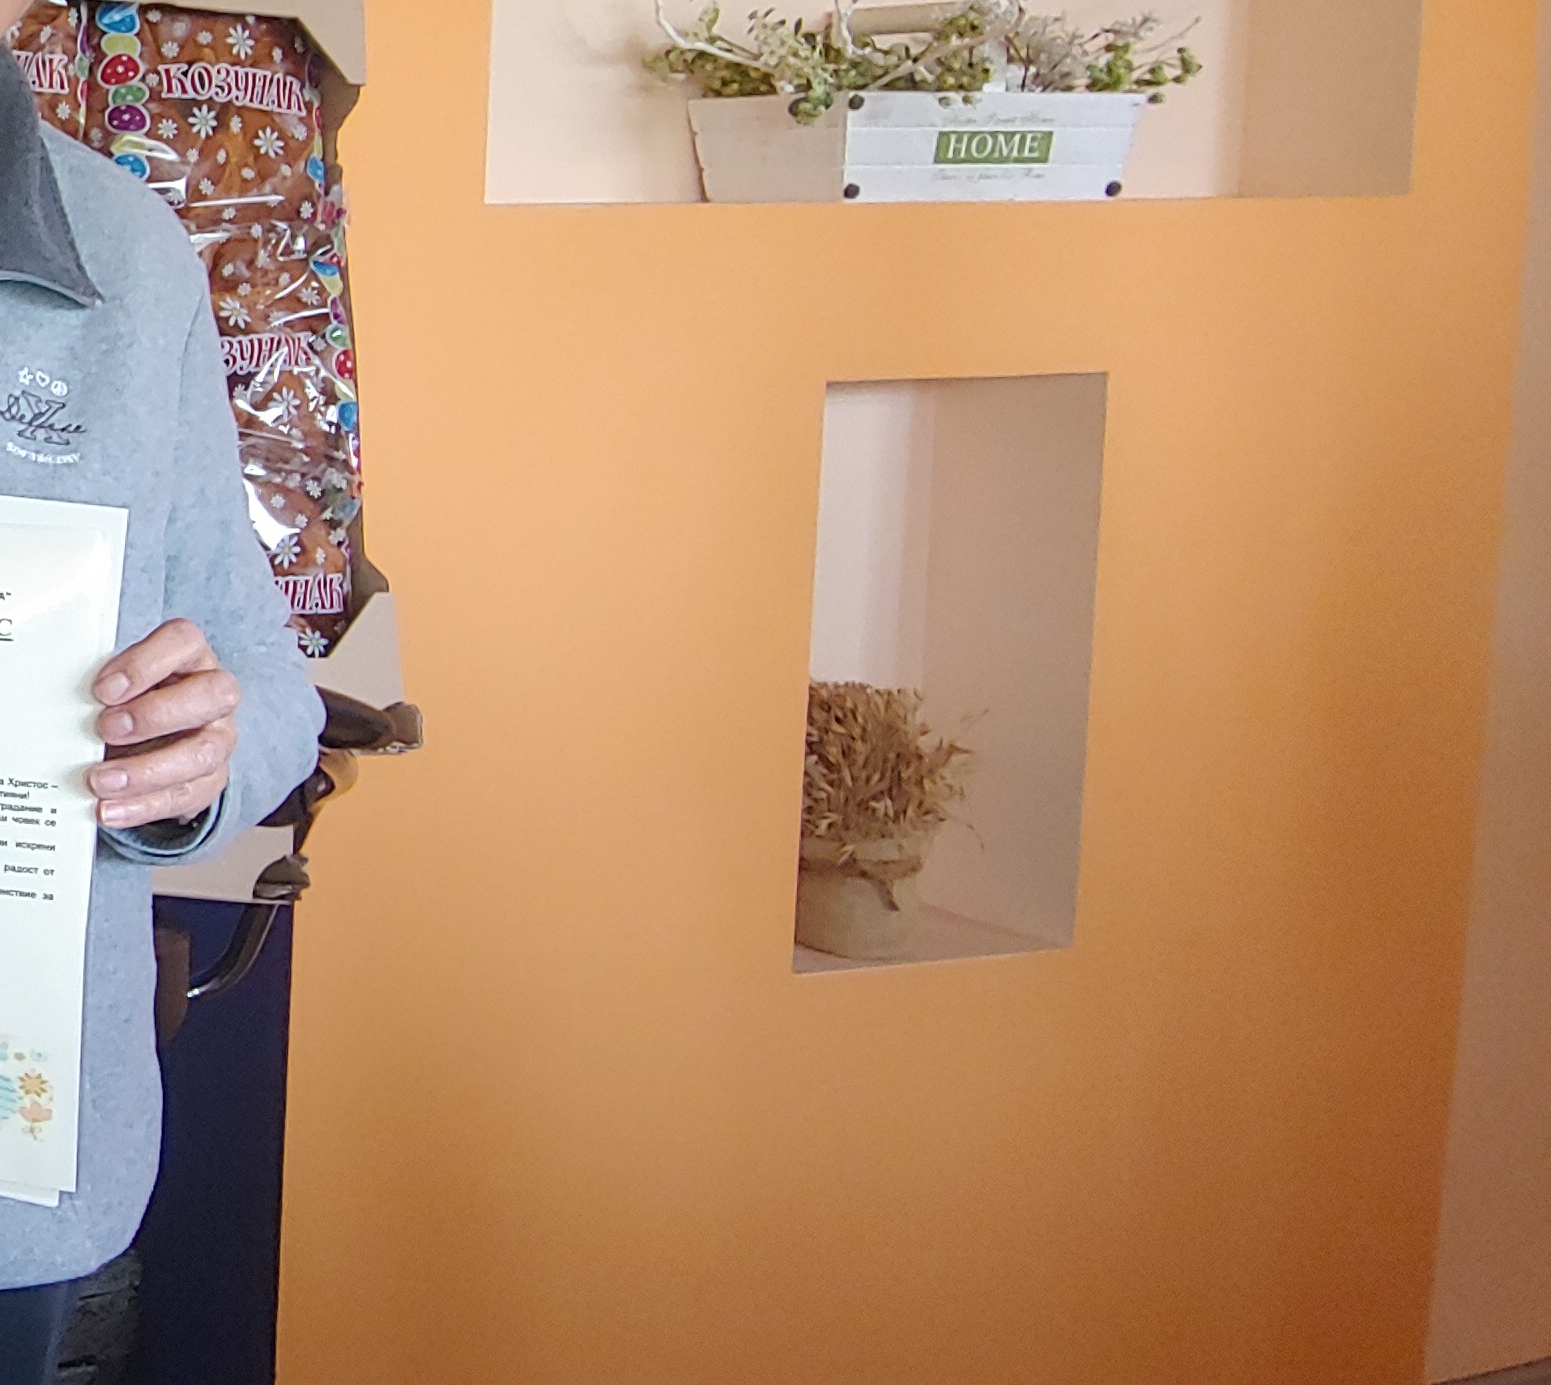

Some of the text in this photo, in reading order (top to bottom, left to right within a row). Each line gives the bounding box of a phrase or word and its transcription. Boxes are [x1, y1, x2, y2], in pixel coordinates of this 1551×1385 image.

[159, 62, 308, 116] КОЗУНАК
[946, 133, 1043, 159] HOME
[220, 331, 317, 375] ЗУНАК
